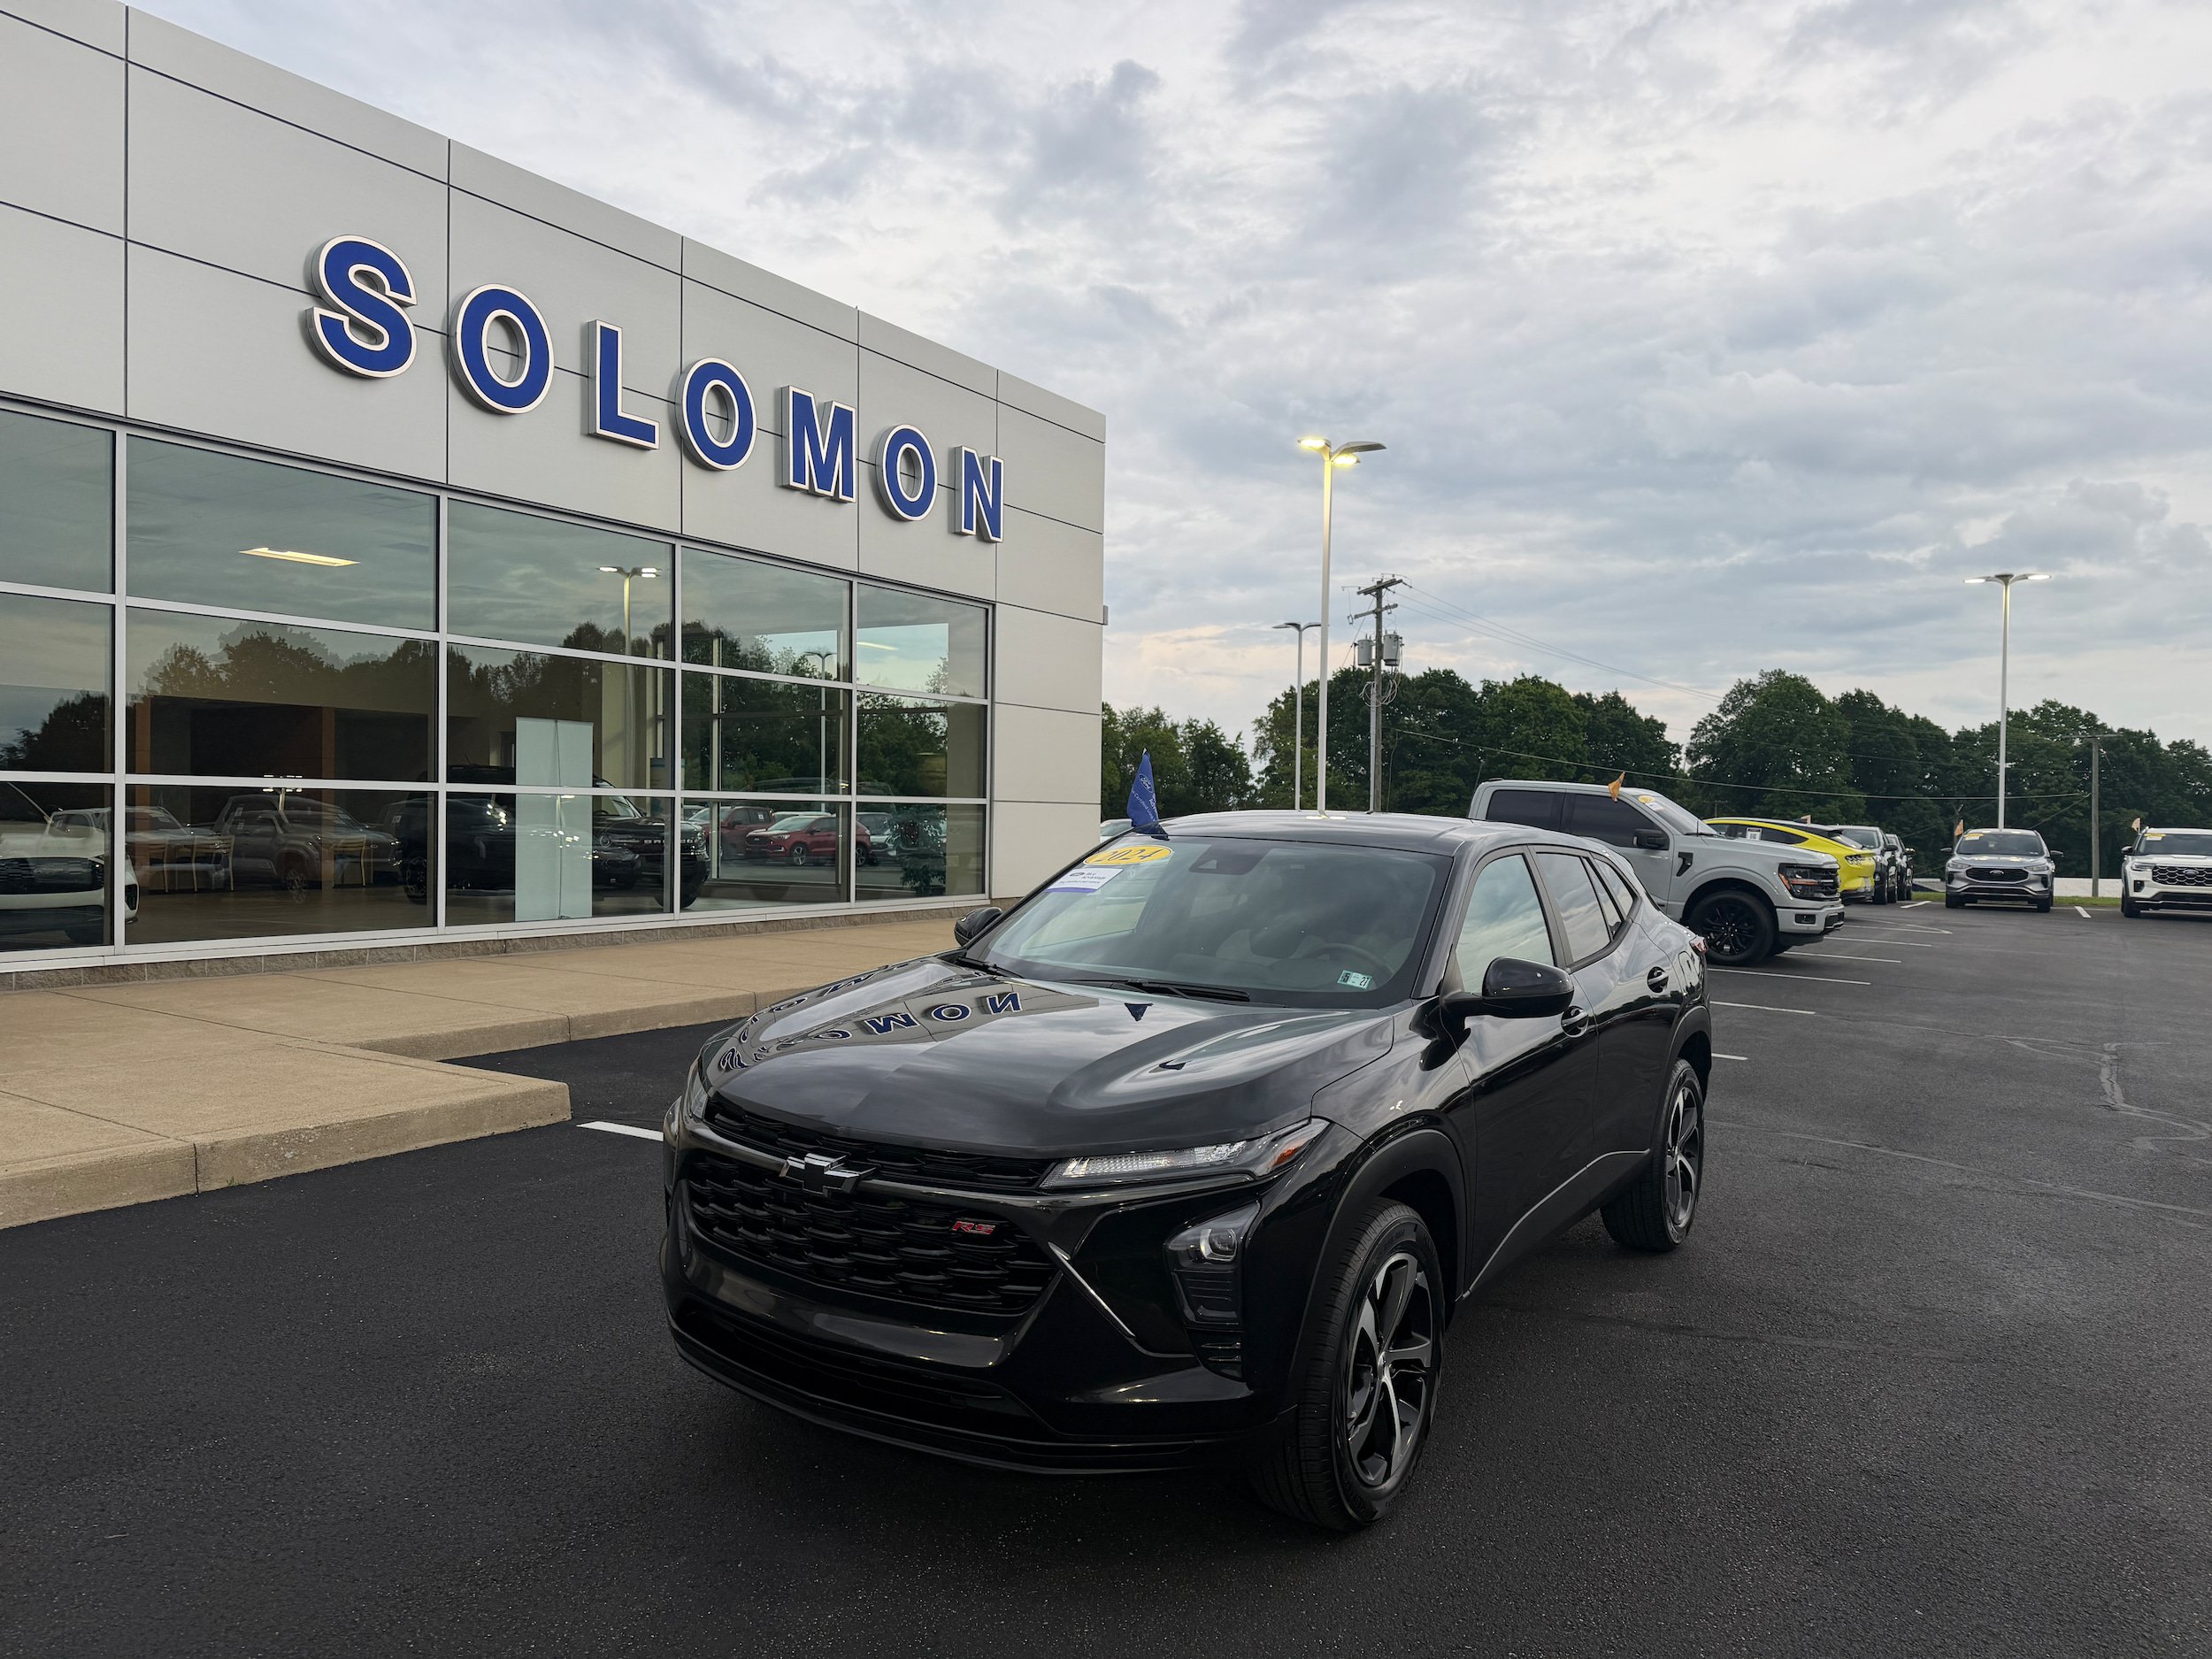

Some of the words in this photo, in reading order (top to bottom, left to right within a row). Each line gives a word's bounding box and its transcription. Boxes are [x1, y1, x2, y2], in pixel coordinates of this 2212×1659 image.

[306, 234, 1005, 543] SOLOMON
[1094, 849, 1164, 863] 2024
[952, 1221, 996, 1235] RS
